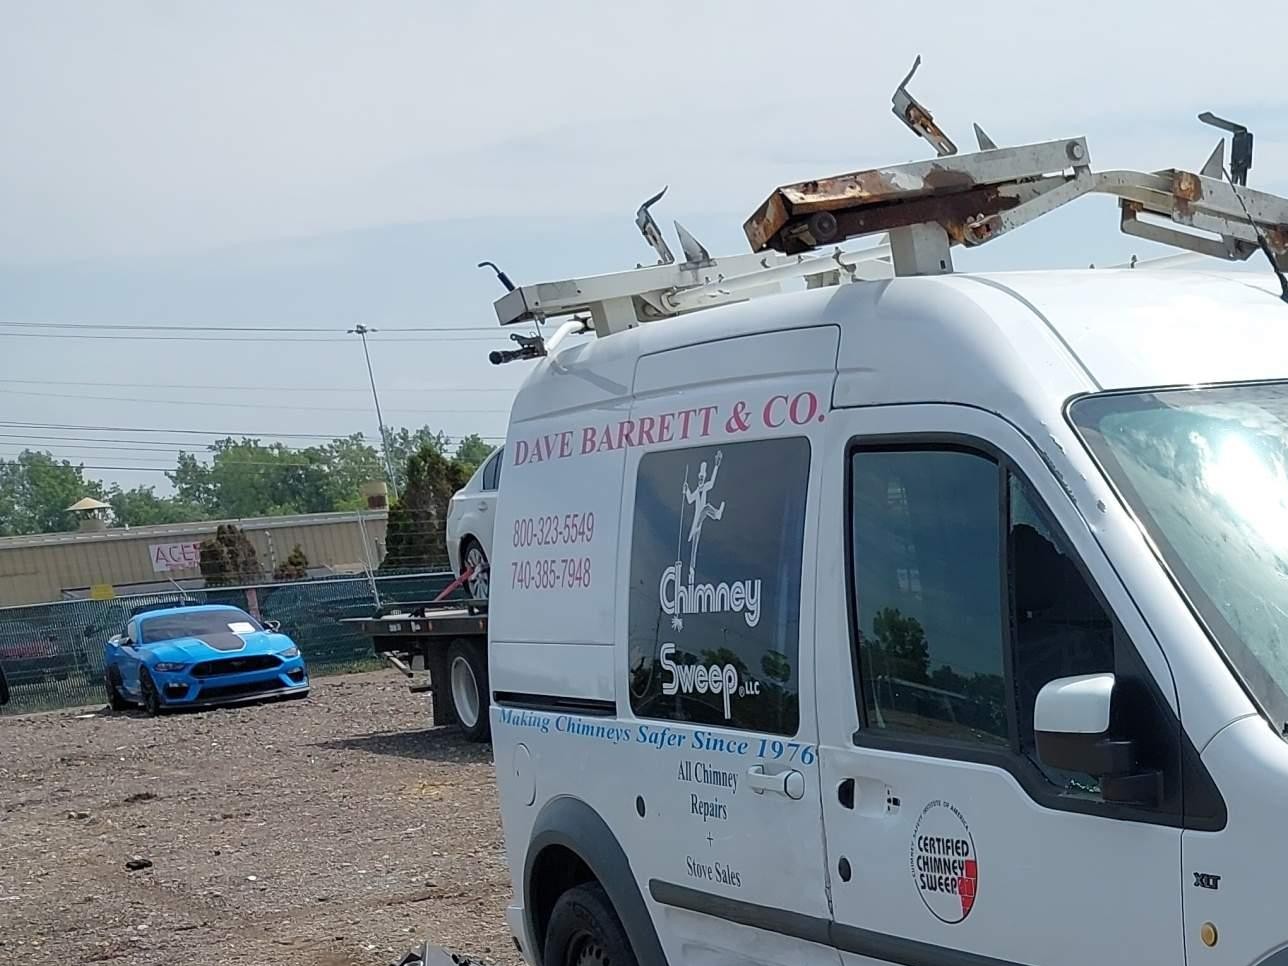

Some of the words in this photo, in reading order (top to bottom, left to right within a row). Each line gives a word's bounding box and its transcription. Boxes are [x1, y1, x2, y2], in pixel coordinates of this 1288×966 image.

[514, 431, 574, 466] DAVE
[581, 405, 719, 456] BARRETT
[725, 401, 752, 433] &
[762, 391, 826, 431] CO.
[512, 512, 595, 548] 800-323-5549
[511, 557, 591, 590] 740-385-7948
[660, 561, 761, 628] Chimney
[660, 642, 738, 720] Sweep
[499, 707, 550, 734] Making
[554, 715, 631, 745] Chimneys
[636, 725, 686, 750] Safer
[692, 731, 748, 755] Since
[756, 739, 816, 766] 1976
[678, 760, 692, 782] All
[694, 762, 739, 794] Chimney
[690, 793, 728, 822] Repairs
[918, 835, 970, 857] CERTIFIED
[686, 855, 713, 881] Stove
[714, 862, 742, 888] Sales
[916, 855, 965, 877] CHIMNEY
[920, 873, 957, 895] SWEEP
